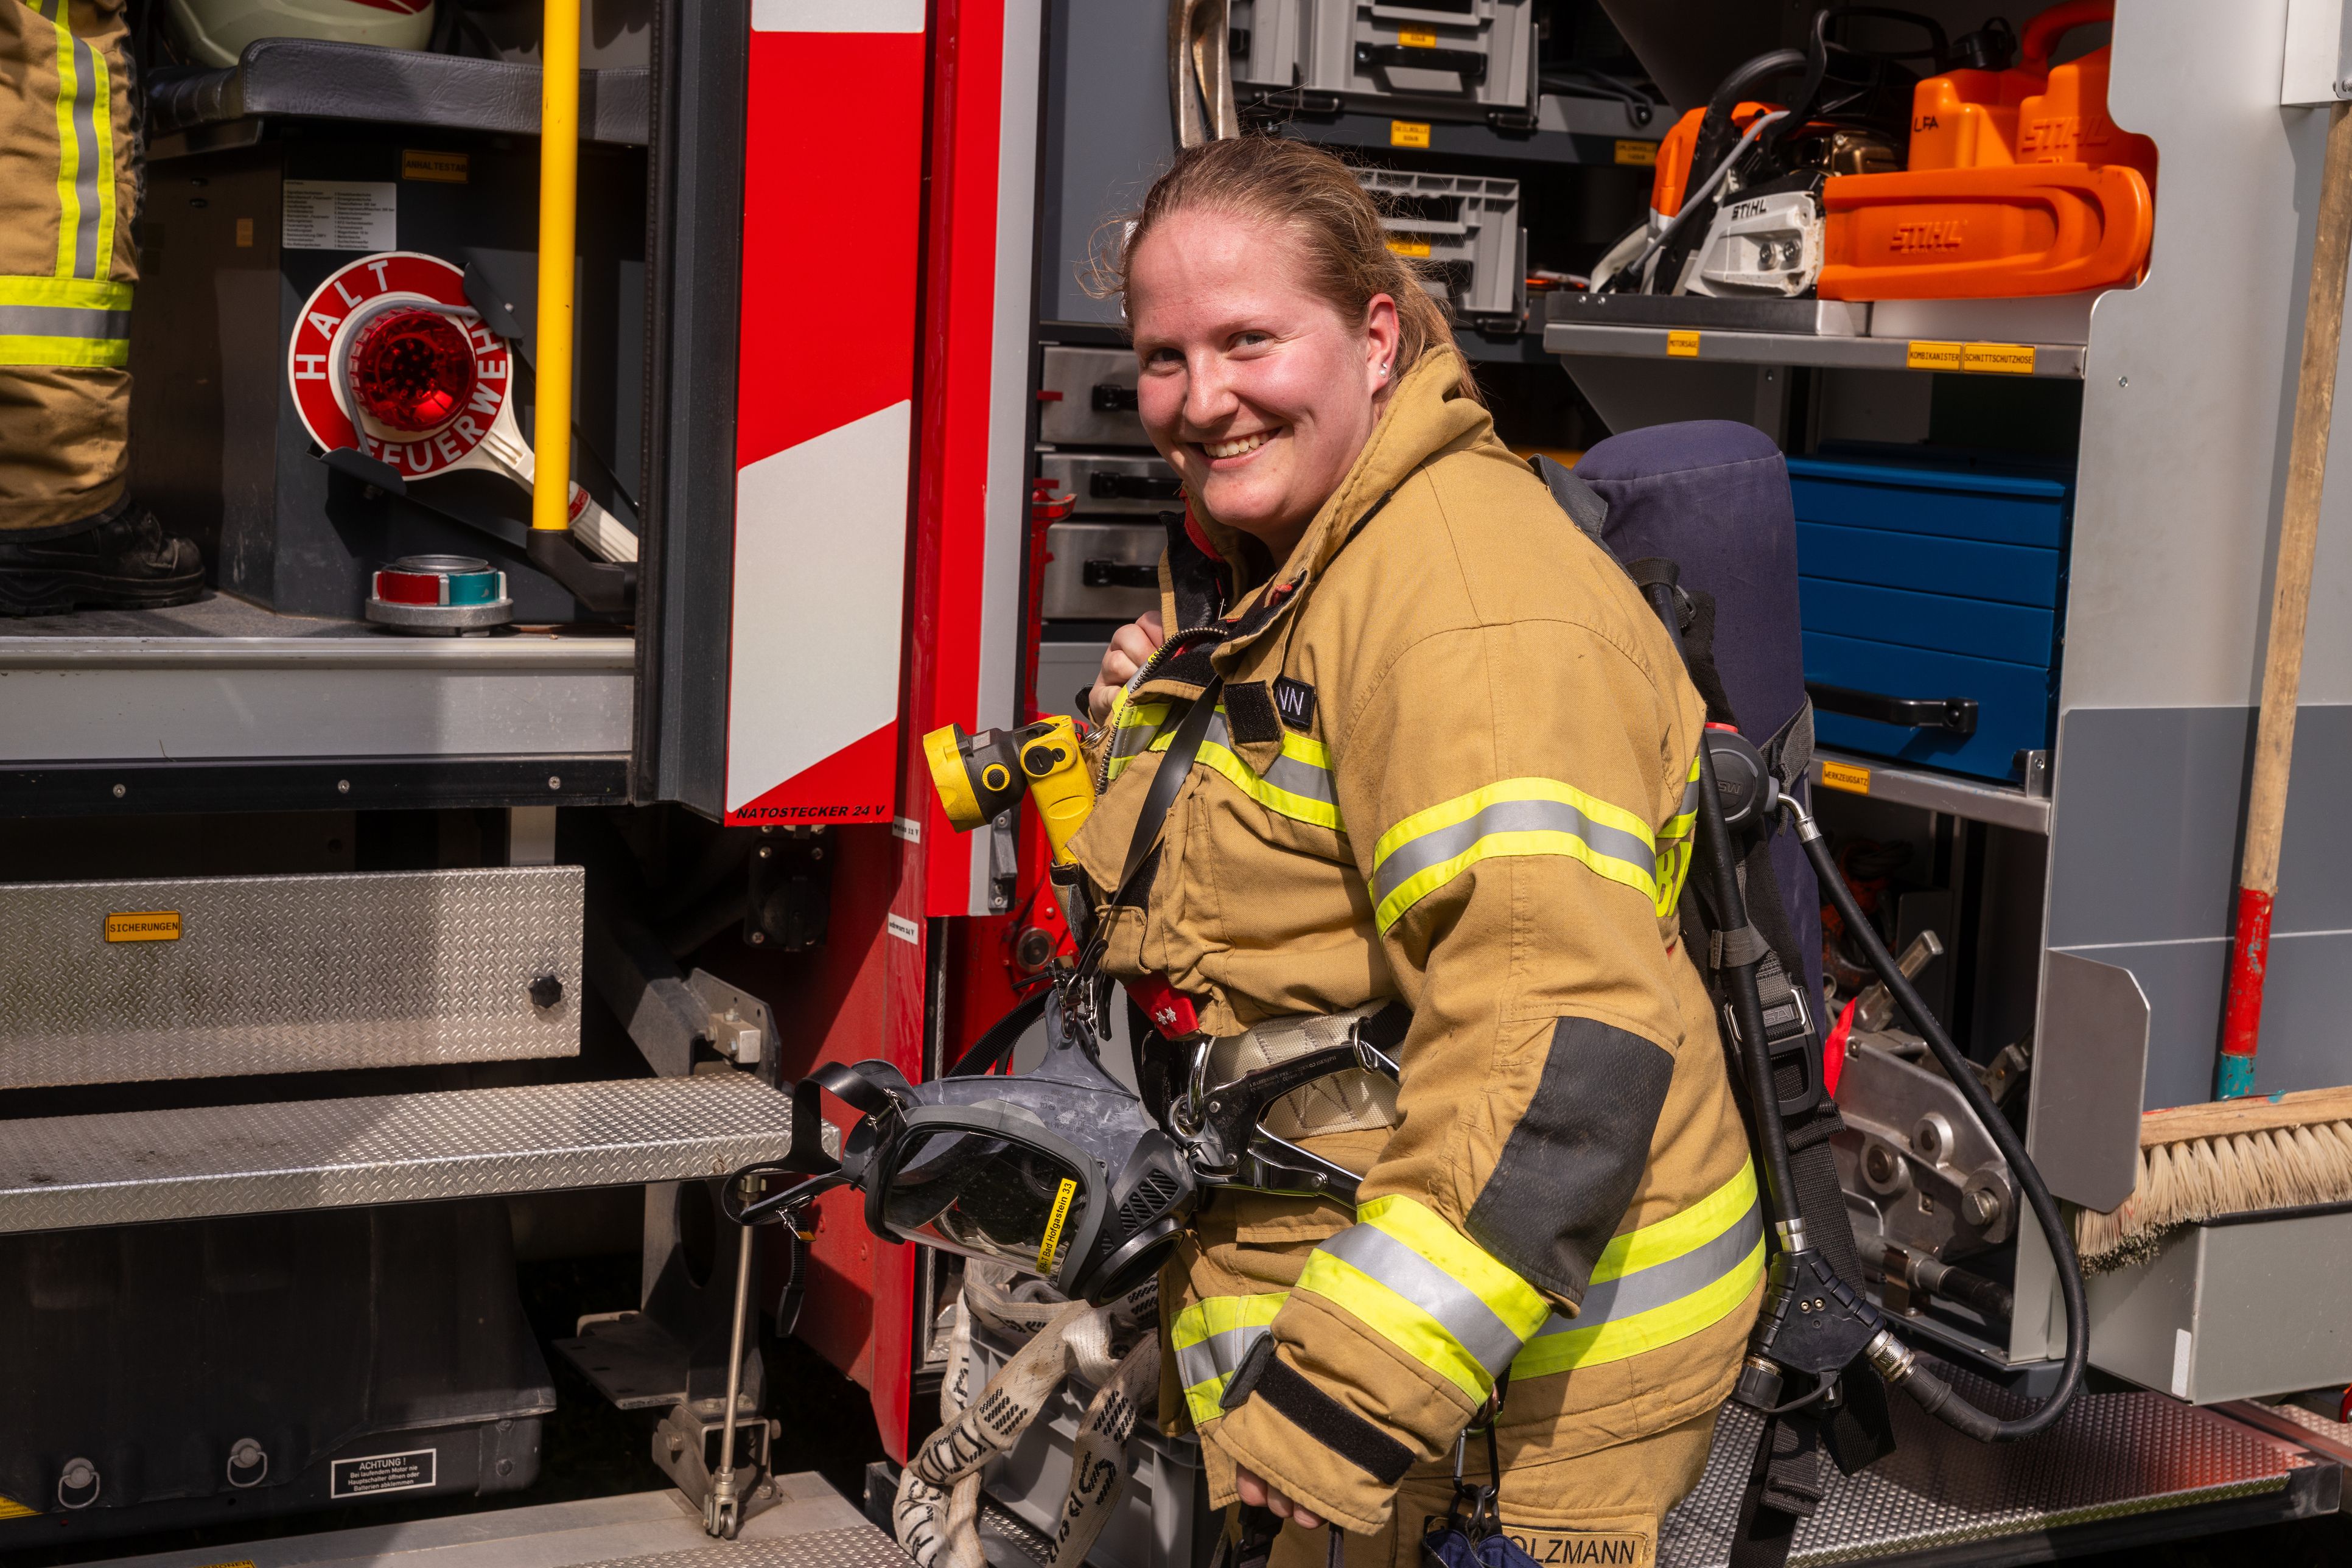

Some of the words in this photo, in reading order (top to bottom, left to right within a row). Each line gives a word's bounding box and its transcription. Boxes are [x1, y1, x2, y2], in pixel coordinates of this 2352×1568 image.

[1914, 116, 1939, 132] LFA
[2021, 116, 2110, 153] STIHL
[406, 160, 467, 173] ANHALTESTAB
[1731, 198, 1766, 222] STIHL
[1890, 221, 1962, 251] STIHL
[295, 259, 389, 380] HALT
[1910, 351, 1959, 361] KOMBIKANISTER
[1965, 353, 2033, 364] SCHNITTSCHUTZHOSE
[357, 315, 507, 473] EUERWEH
[1825, 771, 1868, 786] WERKZEUGSATZ
[736, 806, 849, 819] NATOSTECKER
[853, 805, 870, 816] 24
[875, 805, 886, 816] V
[110, 922, 178, 933] SICHERUNGEN
[1062, 1183, 1073, 1194] 33
[1047, 1195, 1068, 1242] Hofgastein
[1043, 1243, 1053, 1258] Bad
[359, 1458, 401, 1471] ACHTUNG
[348, 1475, 387, 1486] Hauptschalter
[380, 1479, 415, 1488] abklemmen
